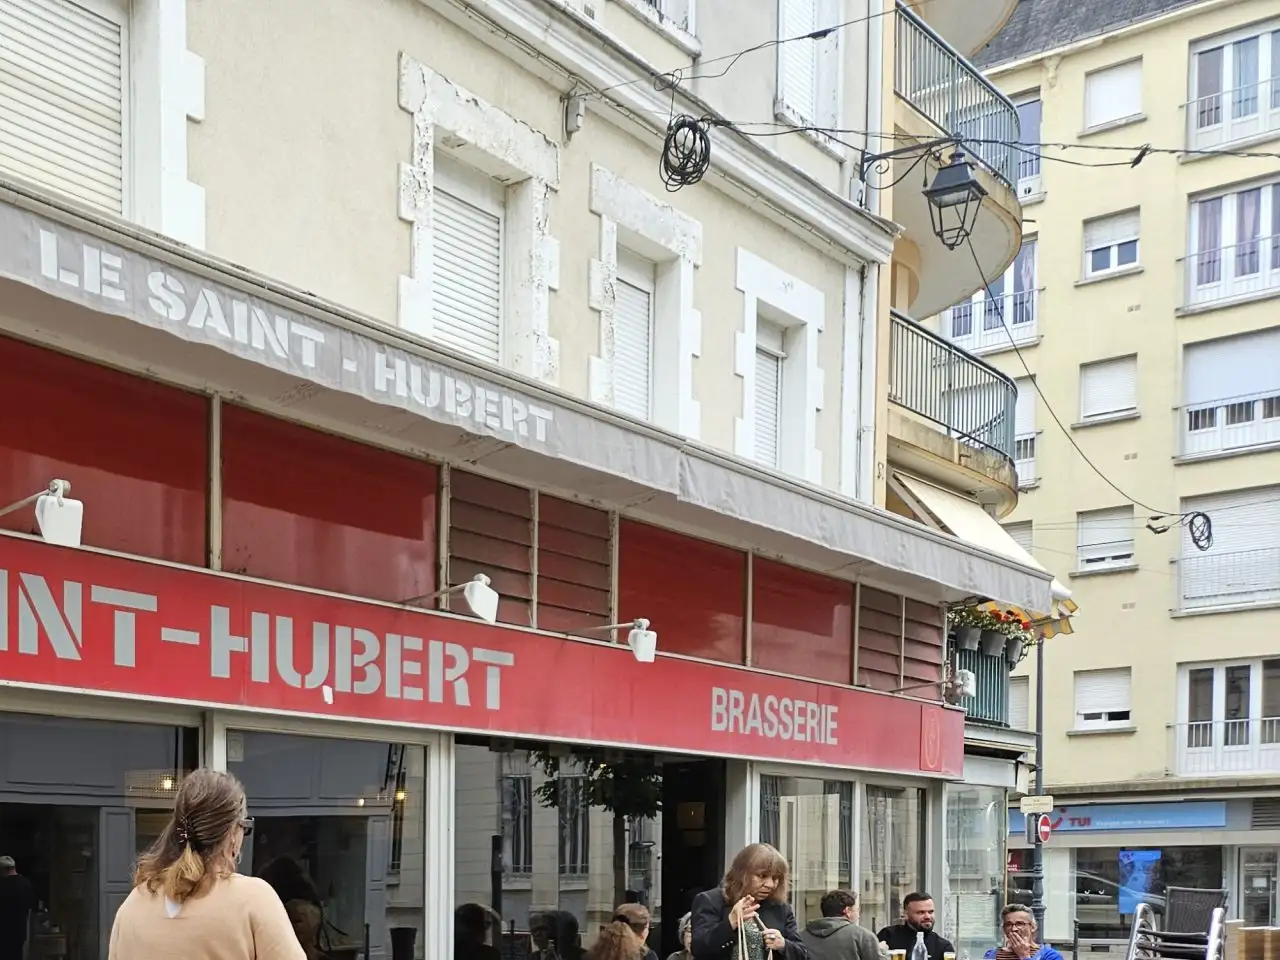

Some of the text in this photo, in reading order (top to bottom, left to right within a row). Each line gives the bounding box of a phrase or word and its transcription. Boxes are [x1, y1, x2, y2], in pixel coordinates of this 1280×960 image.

[39, 228, 126, 302] LE
[147, 270, 325, 368] SAINT
[373, 351, 555, 443] HUBERT
[711, 687, 838, 746] BRASSERIE
[1068, 817, 1091, 827] TUI
